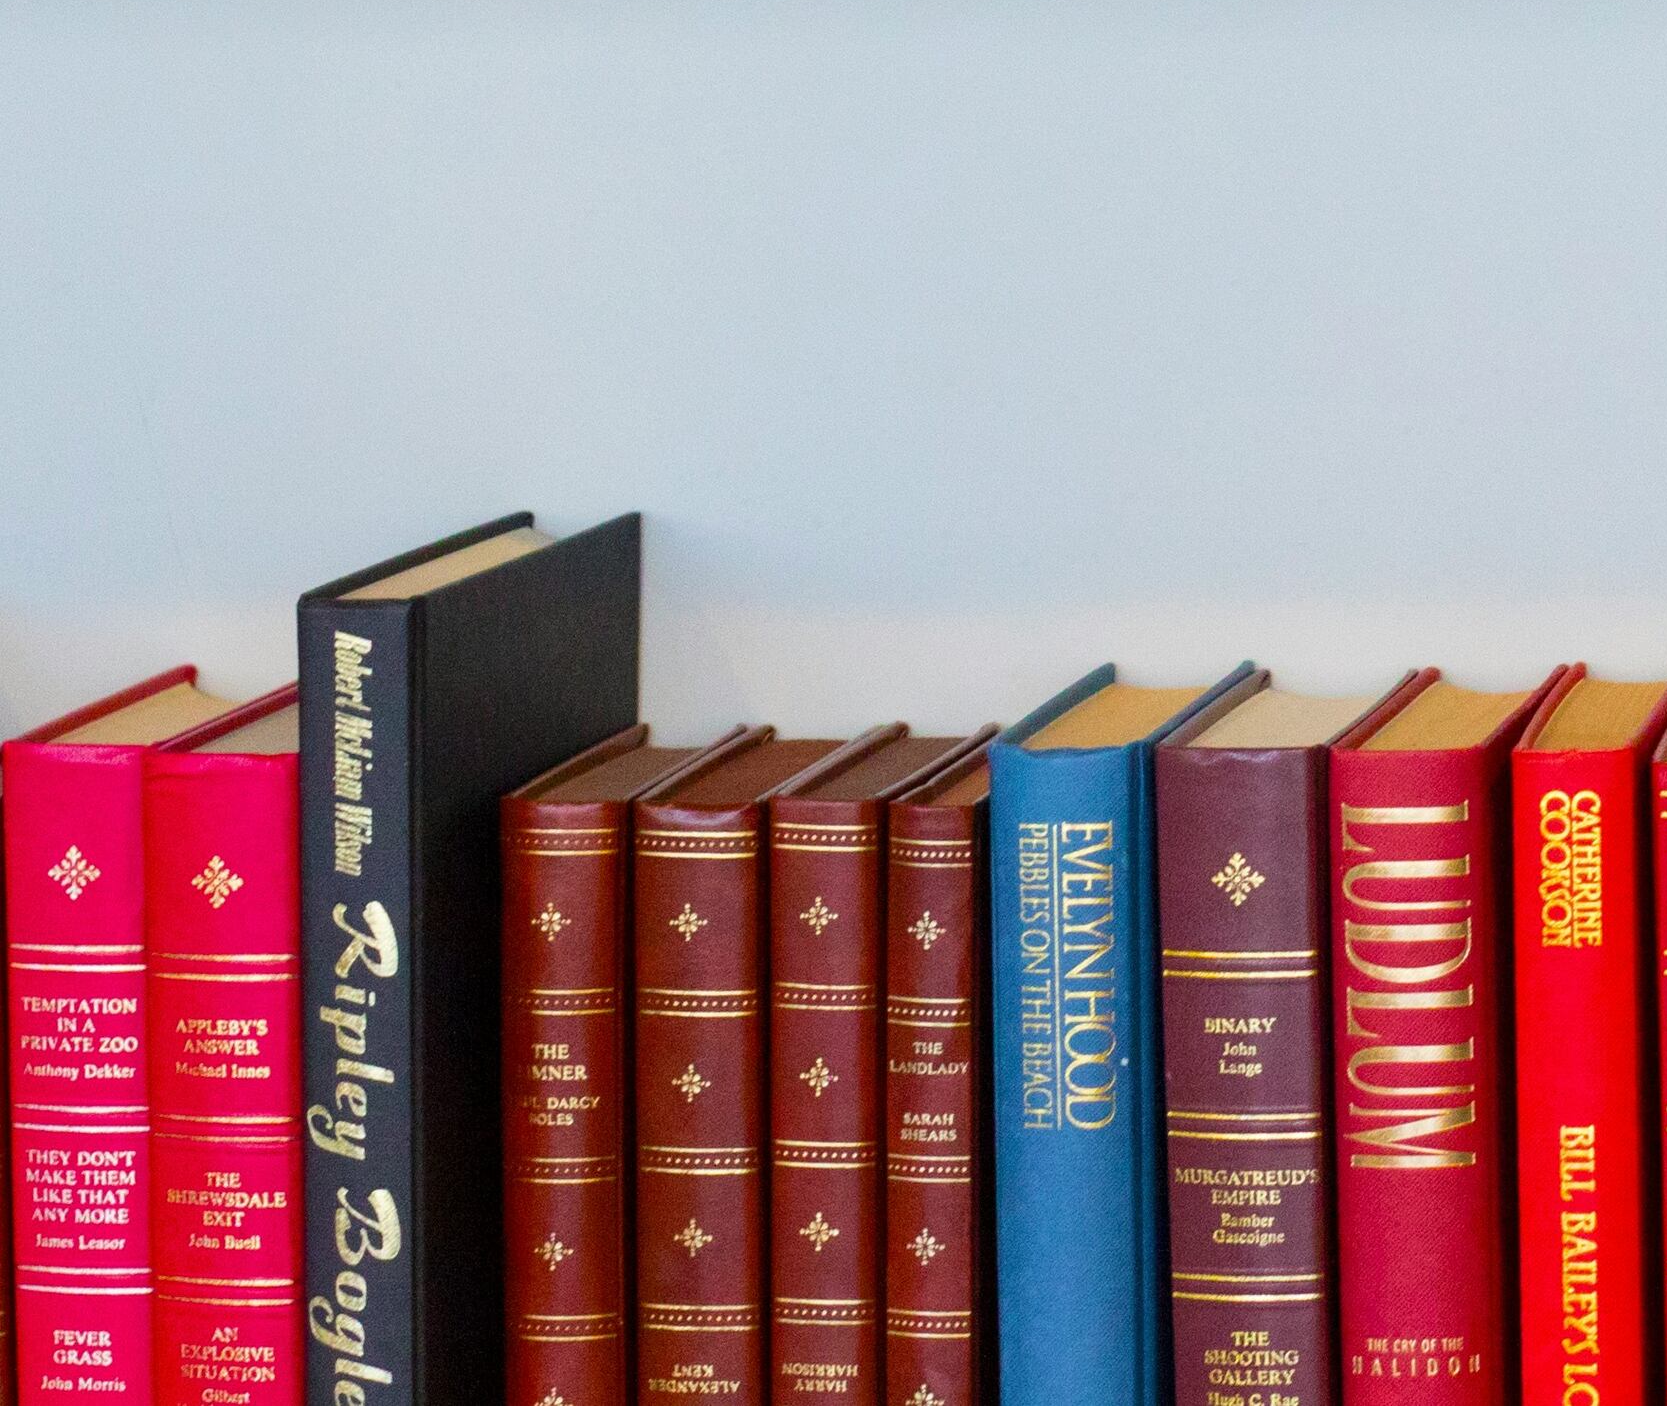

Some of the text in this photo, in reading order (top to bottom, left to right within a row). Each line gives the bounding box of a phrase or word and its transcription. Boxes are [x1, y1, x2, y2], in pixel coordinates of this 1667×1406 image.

[1540, 791, 1571, 948] COOKSON
[1571, 790, 1601, 949] CATHERINE
[22, 1037, 138, 1053] PRIVATE ZOO
[24, 998, 136, 1014] TEMPTATION
[1019, 823, 1053, 1128] PEBBLES ON THE BEACH
[1061, 821, 1114, 1129] EVELYN HOOD
[1205, 1017, 1276, 1034] BINARY
[1342, 801, 1475, 1170] LUDLUM
[307, 901, 401, 1406] Ripley Bogle
[1560, 1125, 1598, 1353] BILL BAILEY'S
[1210, 1369, 1295, 1385] GALLERY
[1231, 1331, 1269, 1347] THE
